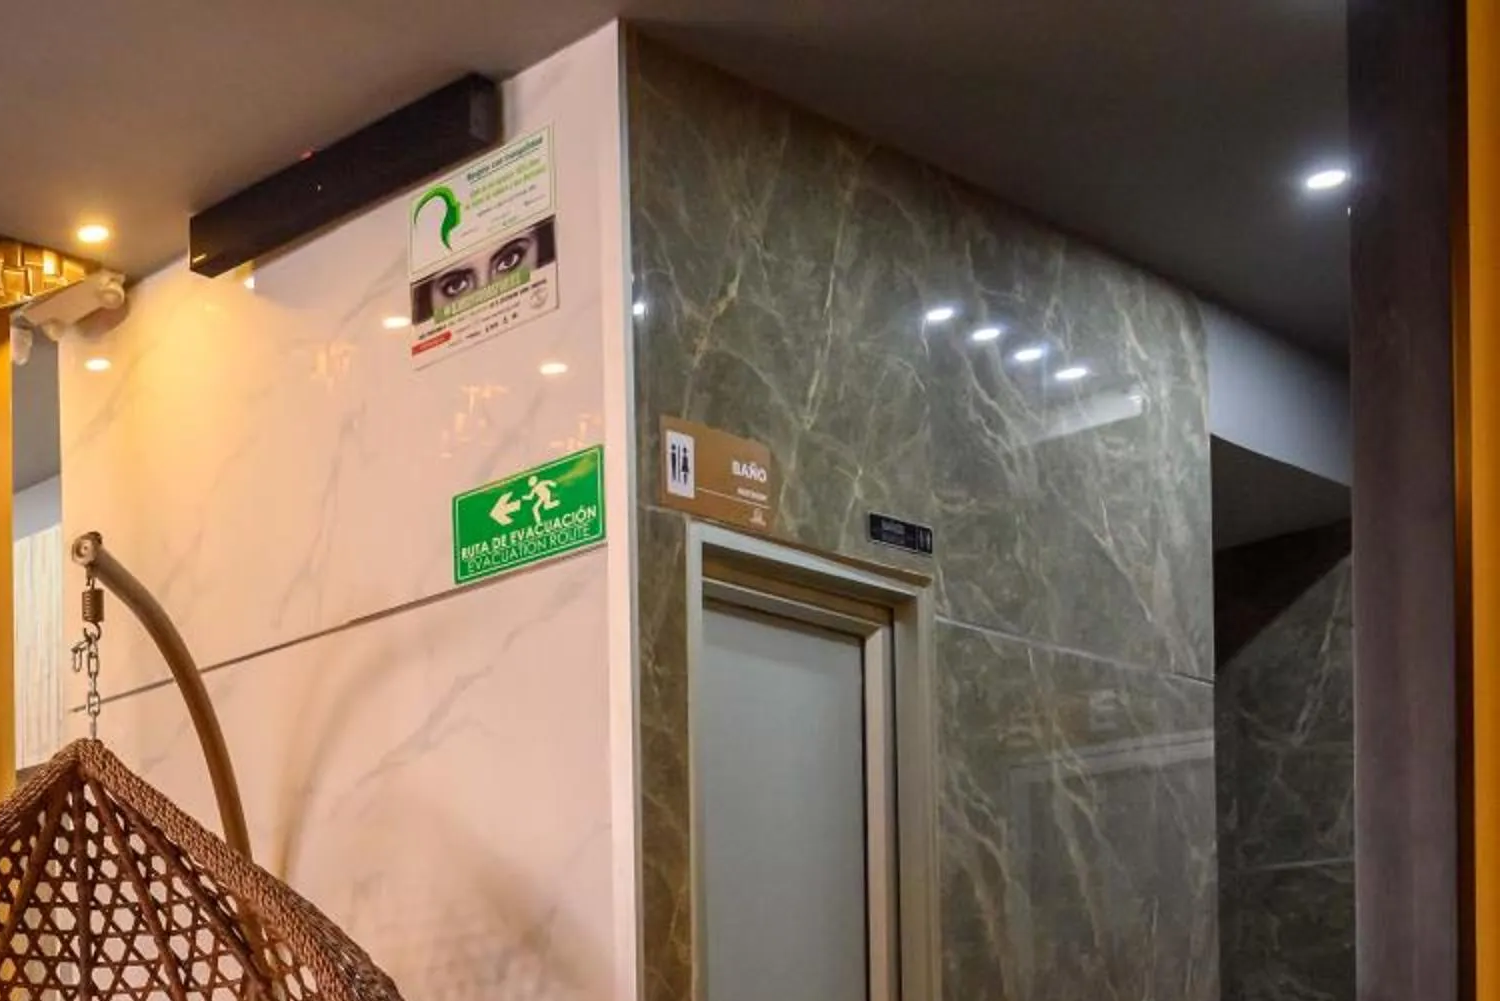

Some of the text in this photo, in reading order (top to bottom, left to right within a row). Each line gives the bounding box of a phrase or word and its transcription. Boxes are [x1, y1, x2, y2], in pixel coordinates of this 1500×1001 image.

[731, 460, 767, 483] BAÑO
[461, 504, 596, 560] RUTA DE EVACUACIÓN
[467, 525, 590, 572] EVACUATION ROUTE
